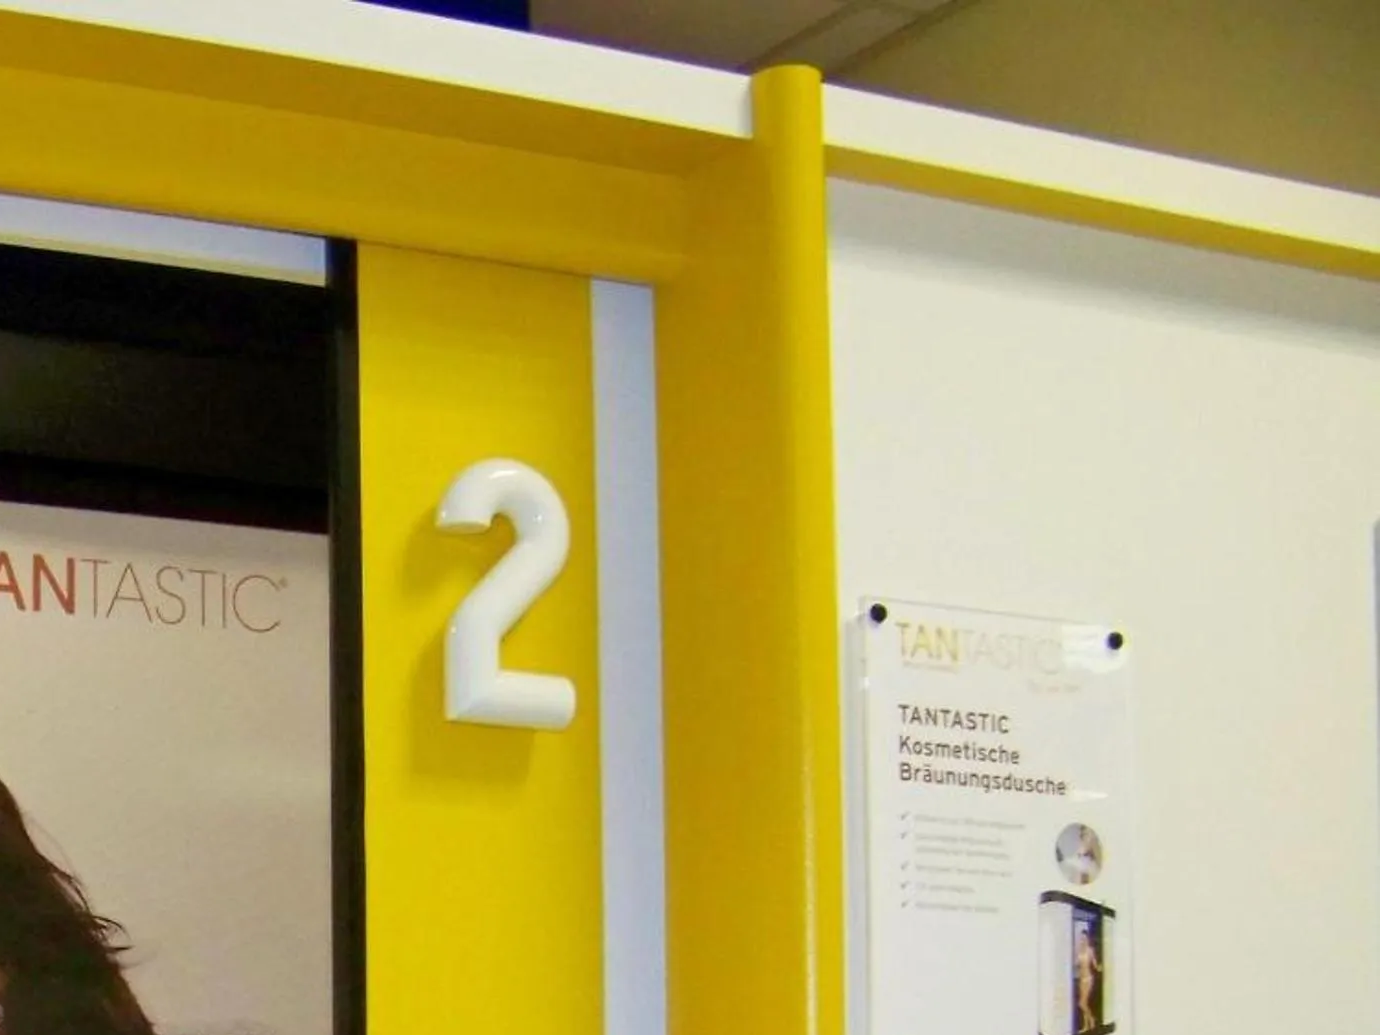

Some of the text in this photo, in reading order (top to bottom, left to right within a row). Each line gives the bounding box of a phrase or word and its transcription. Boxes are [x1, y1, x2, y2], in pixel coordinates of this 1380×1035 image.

[434, 457, 577, 733] 2
[898, 704, 1010, 734] TANTASTIC
[899, 735, 1020, 765] Kosmetische
[899, 762, 1067, 796] Bräunungsdusche
